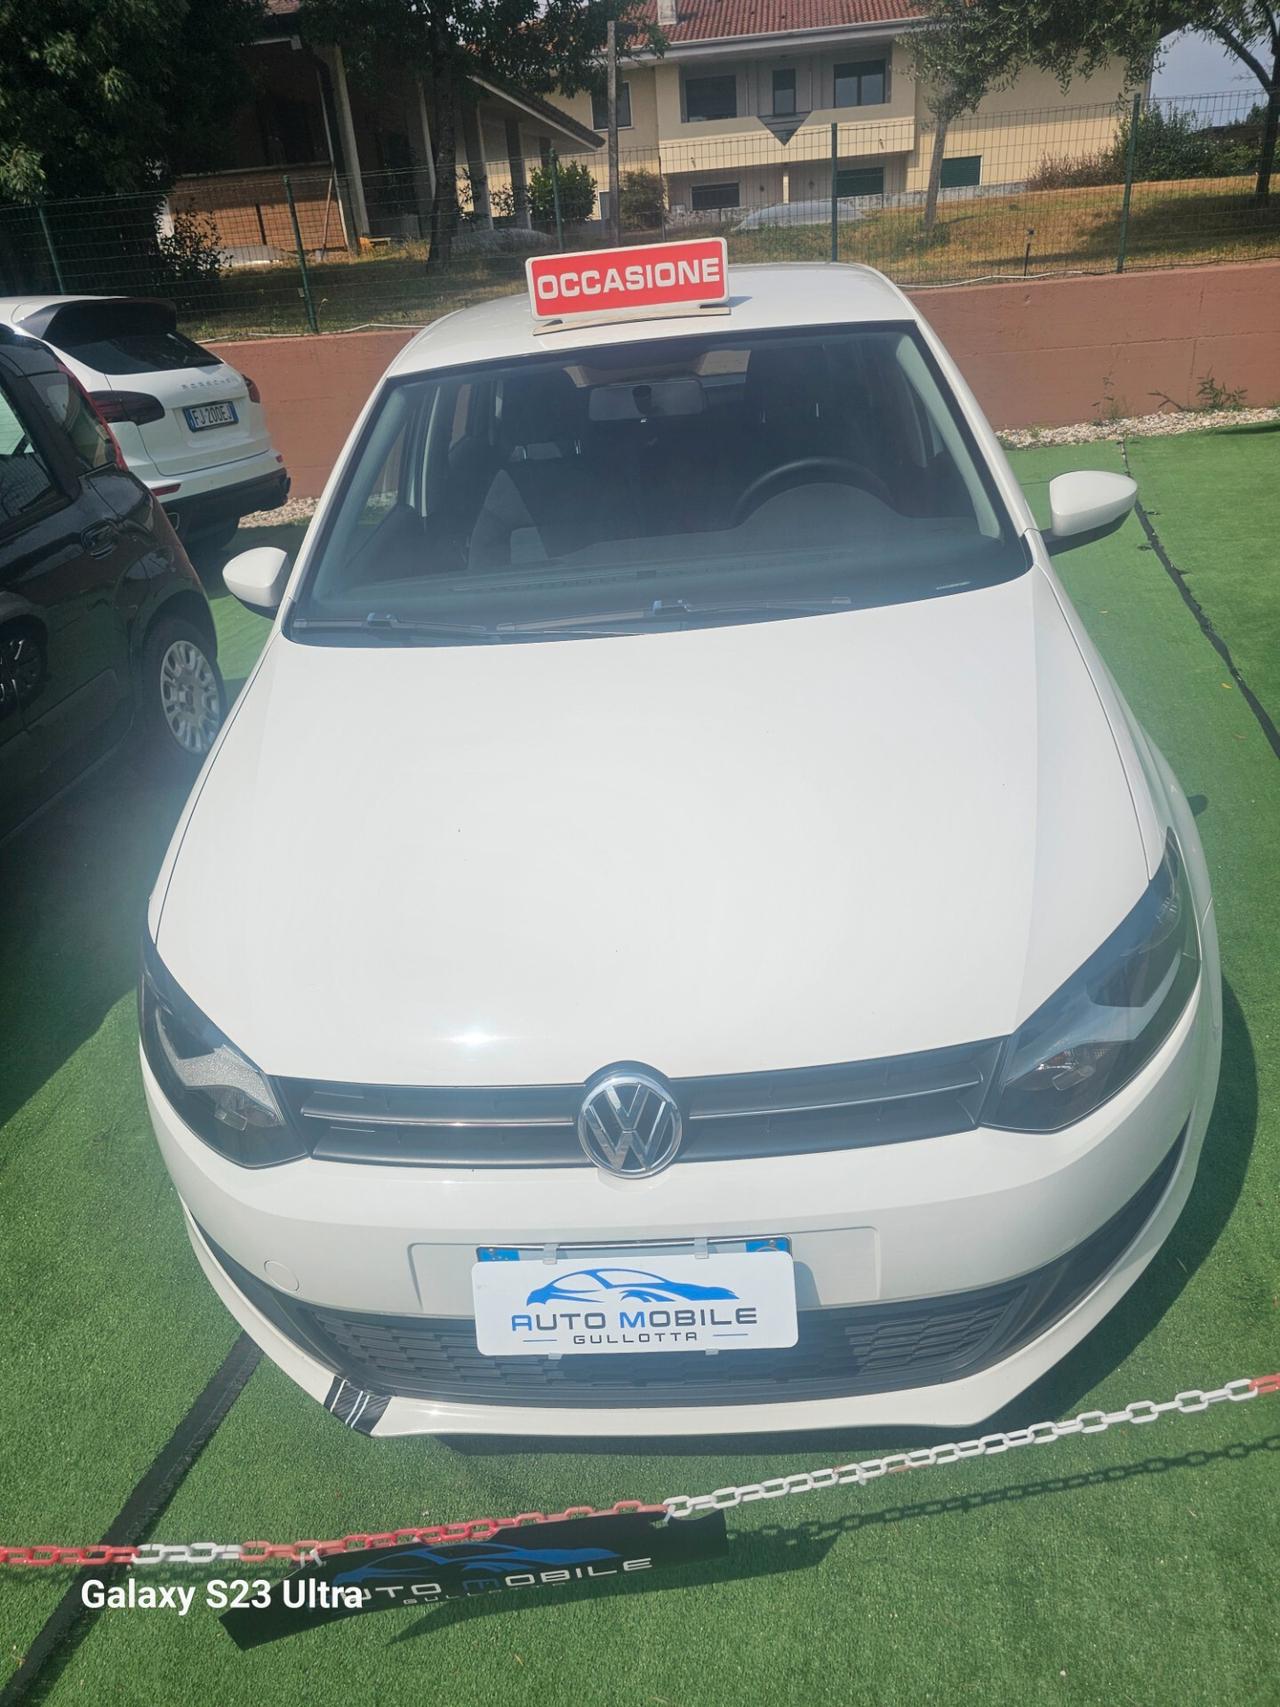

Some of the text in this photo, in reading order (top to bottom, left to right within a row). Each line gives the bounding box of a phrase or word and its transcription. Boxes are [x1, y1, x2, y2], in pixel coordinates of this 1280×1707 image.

[537, 257, 720, 300] OCCASIONE
[511, 1307, 757, 1332] AUTO MOBILE
[573, 1332, 698, 1345] GULLOTTA
